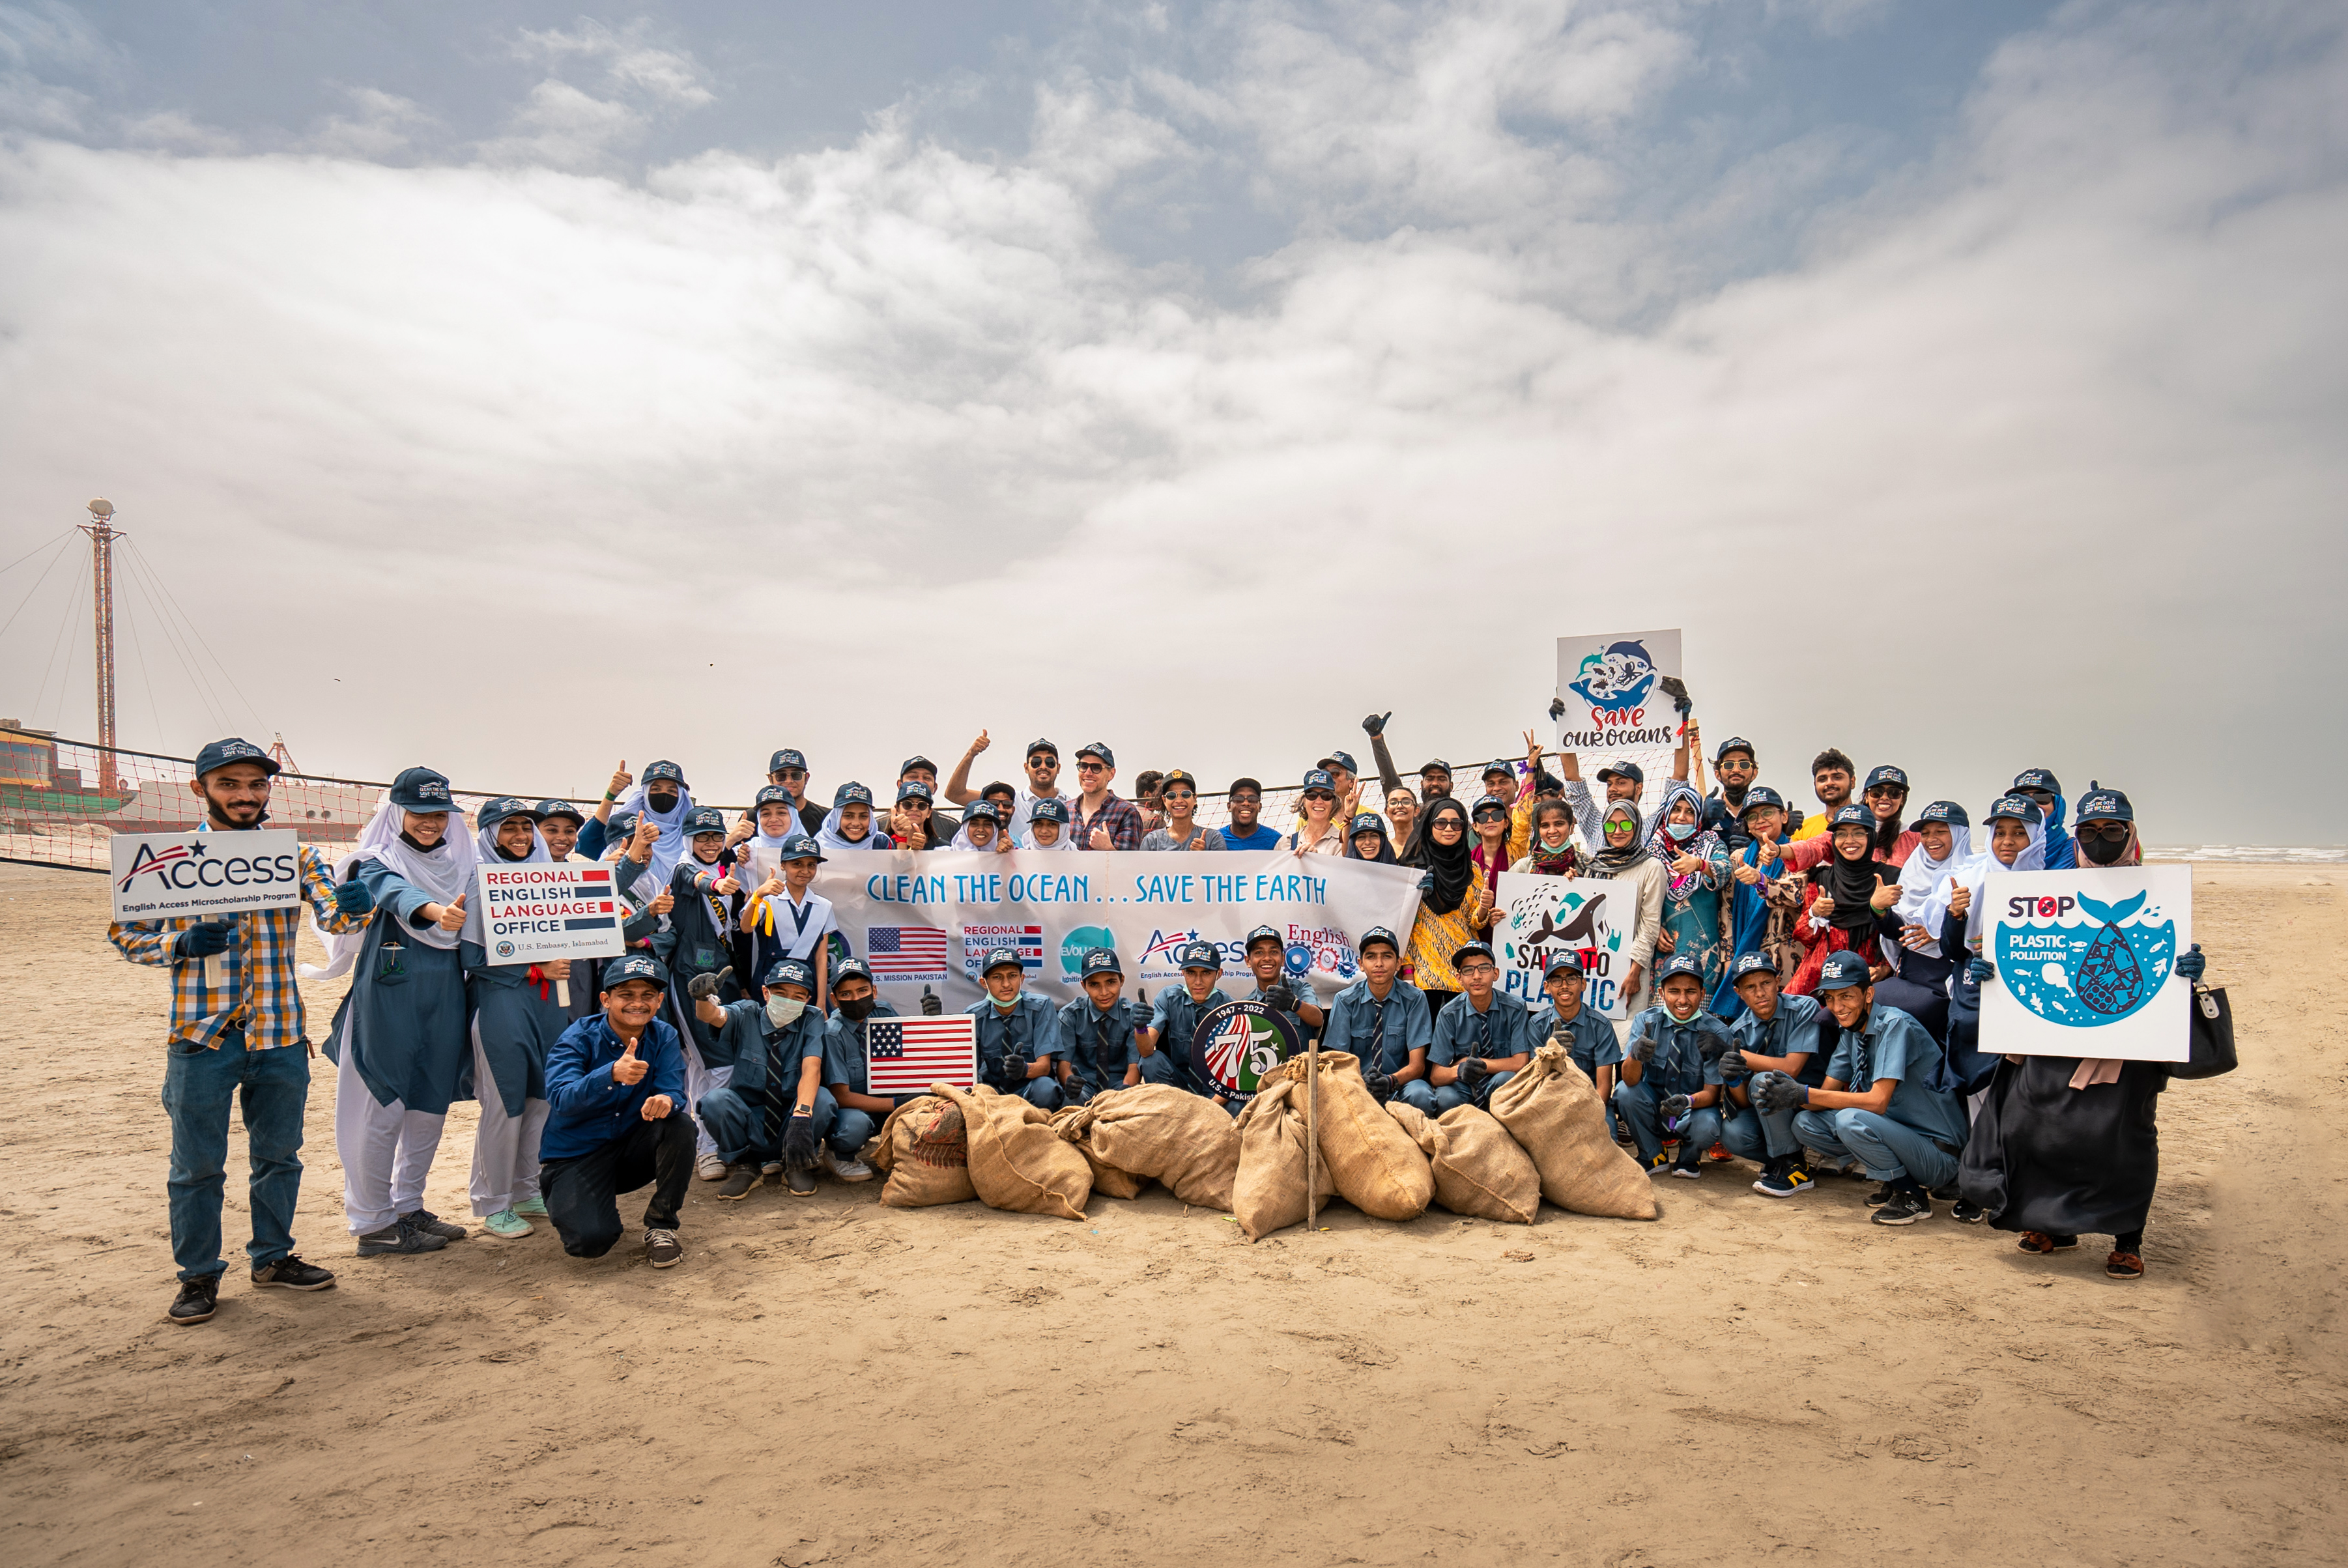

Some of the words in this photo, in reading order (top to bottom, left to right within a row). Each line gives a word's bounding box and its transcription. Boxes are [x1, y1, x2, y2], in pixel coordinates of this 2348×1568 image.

[120, 843, 295, 892] Access
[487, 871, 579, 885] REGIONAL
[489, 887, 571, 902] ENGLISH
[868, 874, 945, 904] CLEAN
[954, 874, 1001, 903] THE
[1010, 874, 1088, 903] OCEAN
[1136, 876, 1194, 903] SAVE
[1201, 876, 1247, 903] THE
[1256, 875, 1326, 905] EARTH
[122, 903, 156, 912] English
[158, 900, 189, 909] Access
[192, 894, 261, 906] Microscholarship
[263, 892, 296, 903] Program
[2008, 896, 2075, 917] STOP
[491, 902, 597, 919] LANGUAGE
[493, 920, 560, 935] OFFICE
[964, 926, 1022, 935] REGIONAL
[572, 939, 608, 947] Islamabad
[966, 937, 1016, 946] ENGLISH
[1287, 924, 1351, 948] English
[2010, 935, 2066, 948] PLASTIC
[2011, 951, 2066, 960] POLLUTION
[1584, 950, 1610, 977] TO
[1216, 1006, 1235, 1018] 1947
[1244, 1005, 1265, 1014] 2022
[1214, 1030, 1277, 1077] 75
[1209, 1079, 1222, 1092] U.S.
